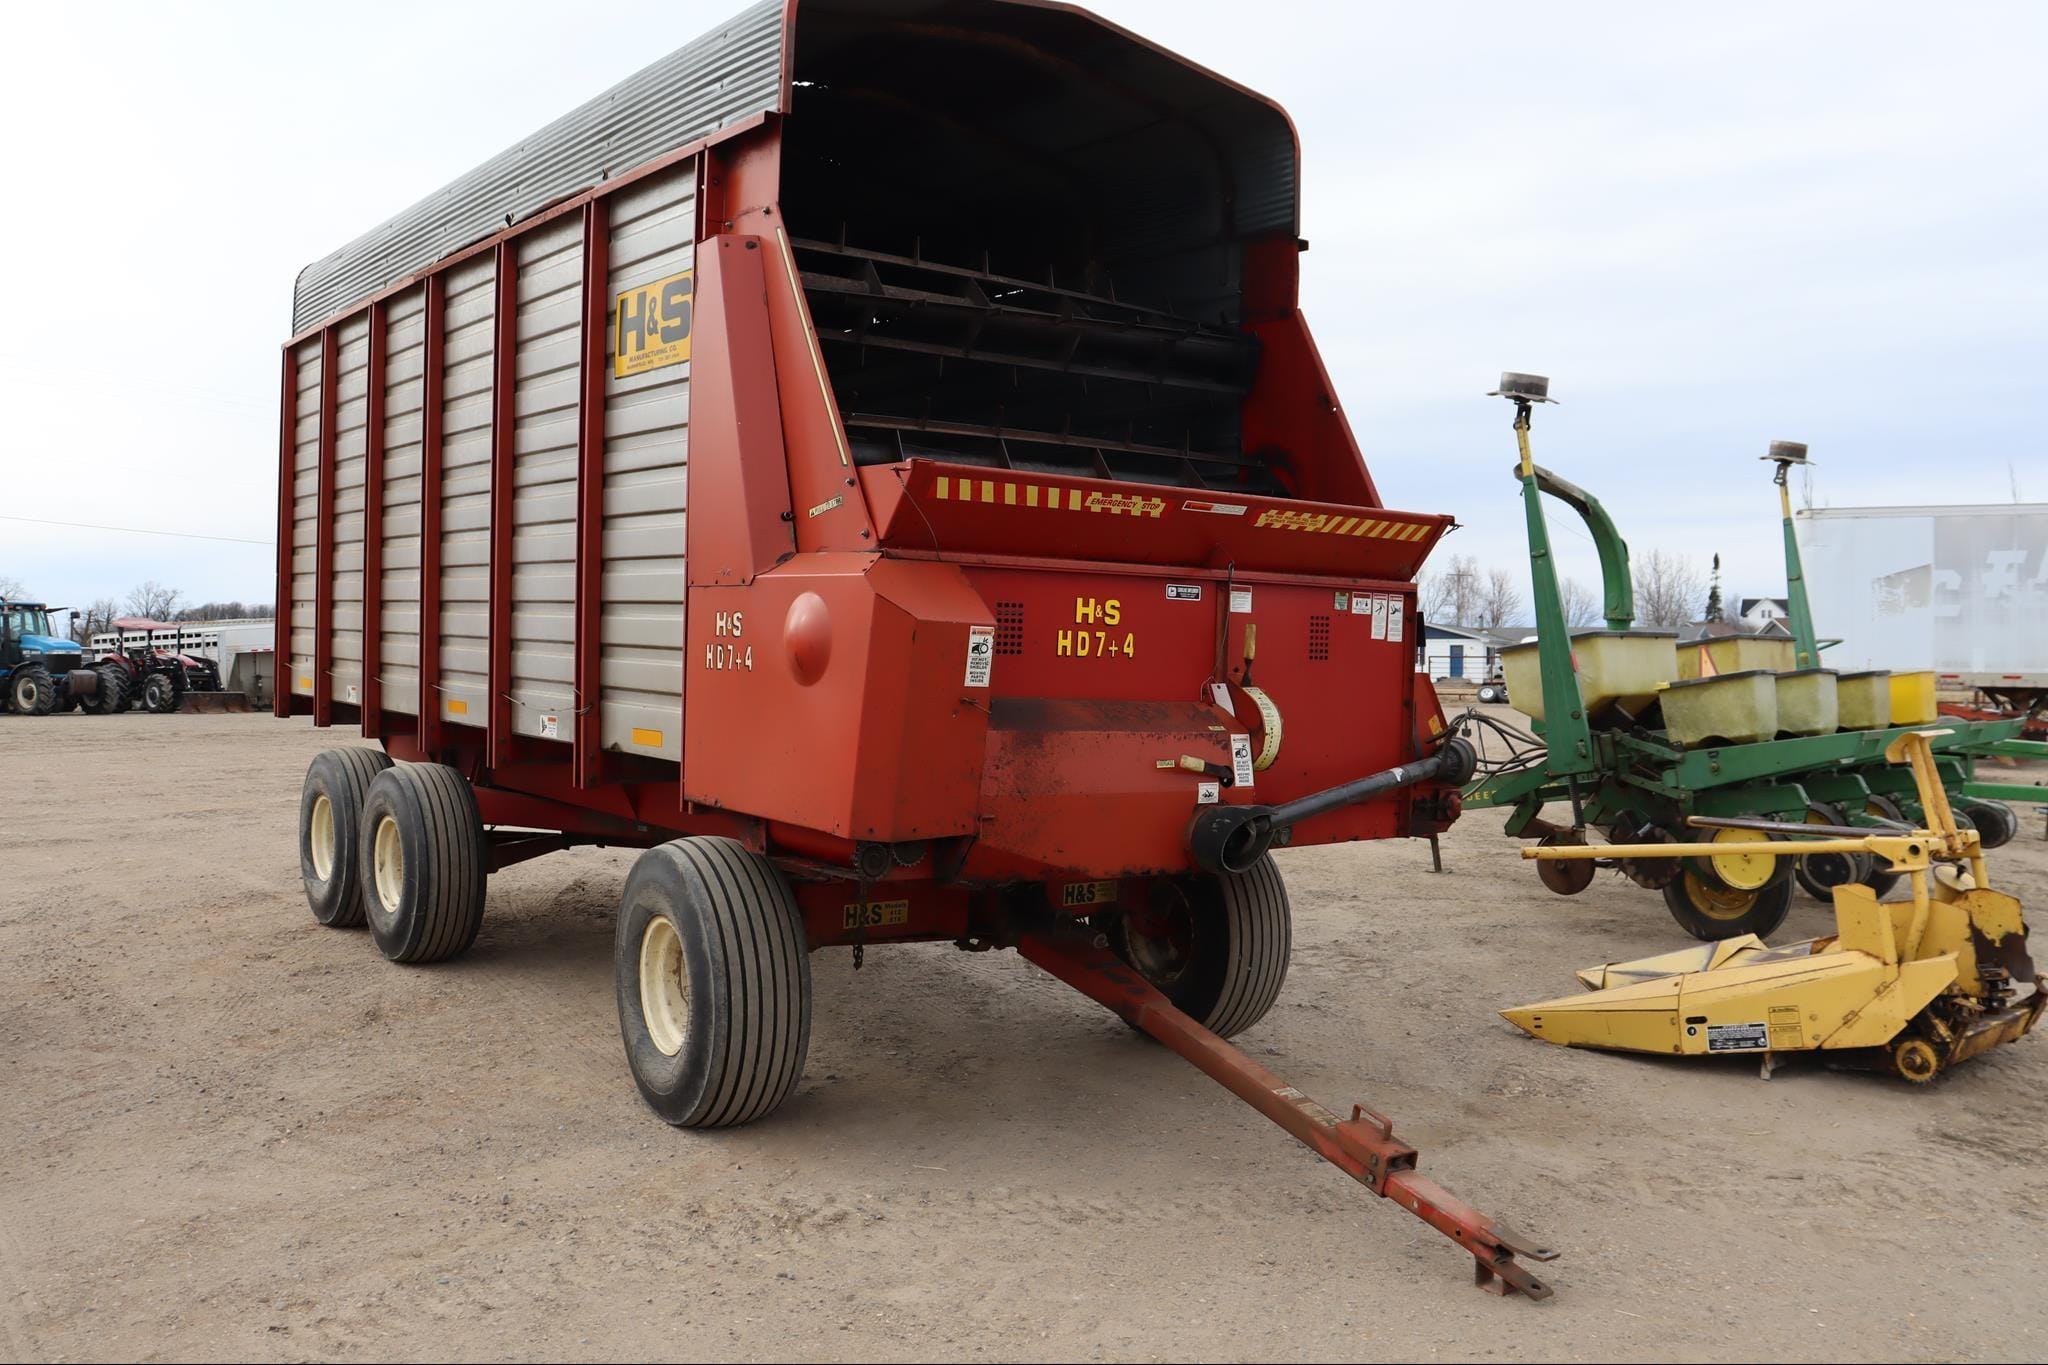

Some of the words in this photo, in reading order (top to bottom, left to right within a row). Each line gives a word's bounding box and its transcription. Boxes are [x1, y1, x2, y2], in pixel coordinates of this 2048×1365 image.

[619, 277, 692, 357] H&S
[1090, 497, 1138, 508] EMERGENCY
[1141, 502, 1161, 510] STOP
[715, 611, 743, 637] H&S
[1075, 597, 1121, 625] H&S
[1064, 883, 1096, 905] H&S
